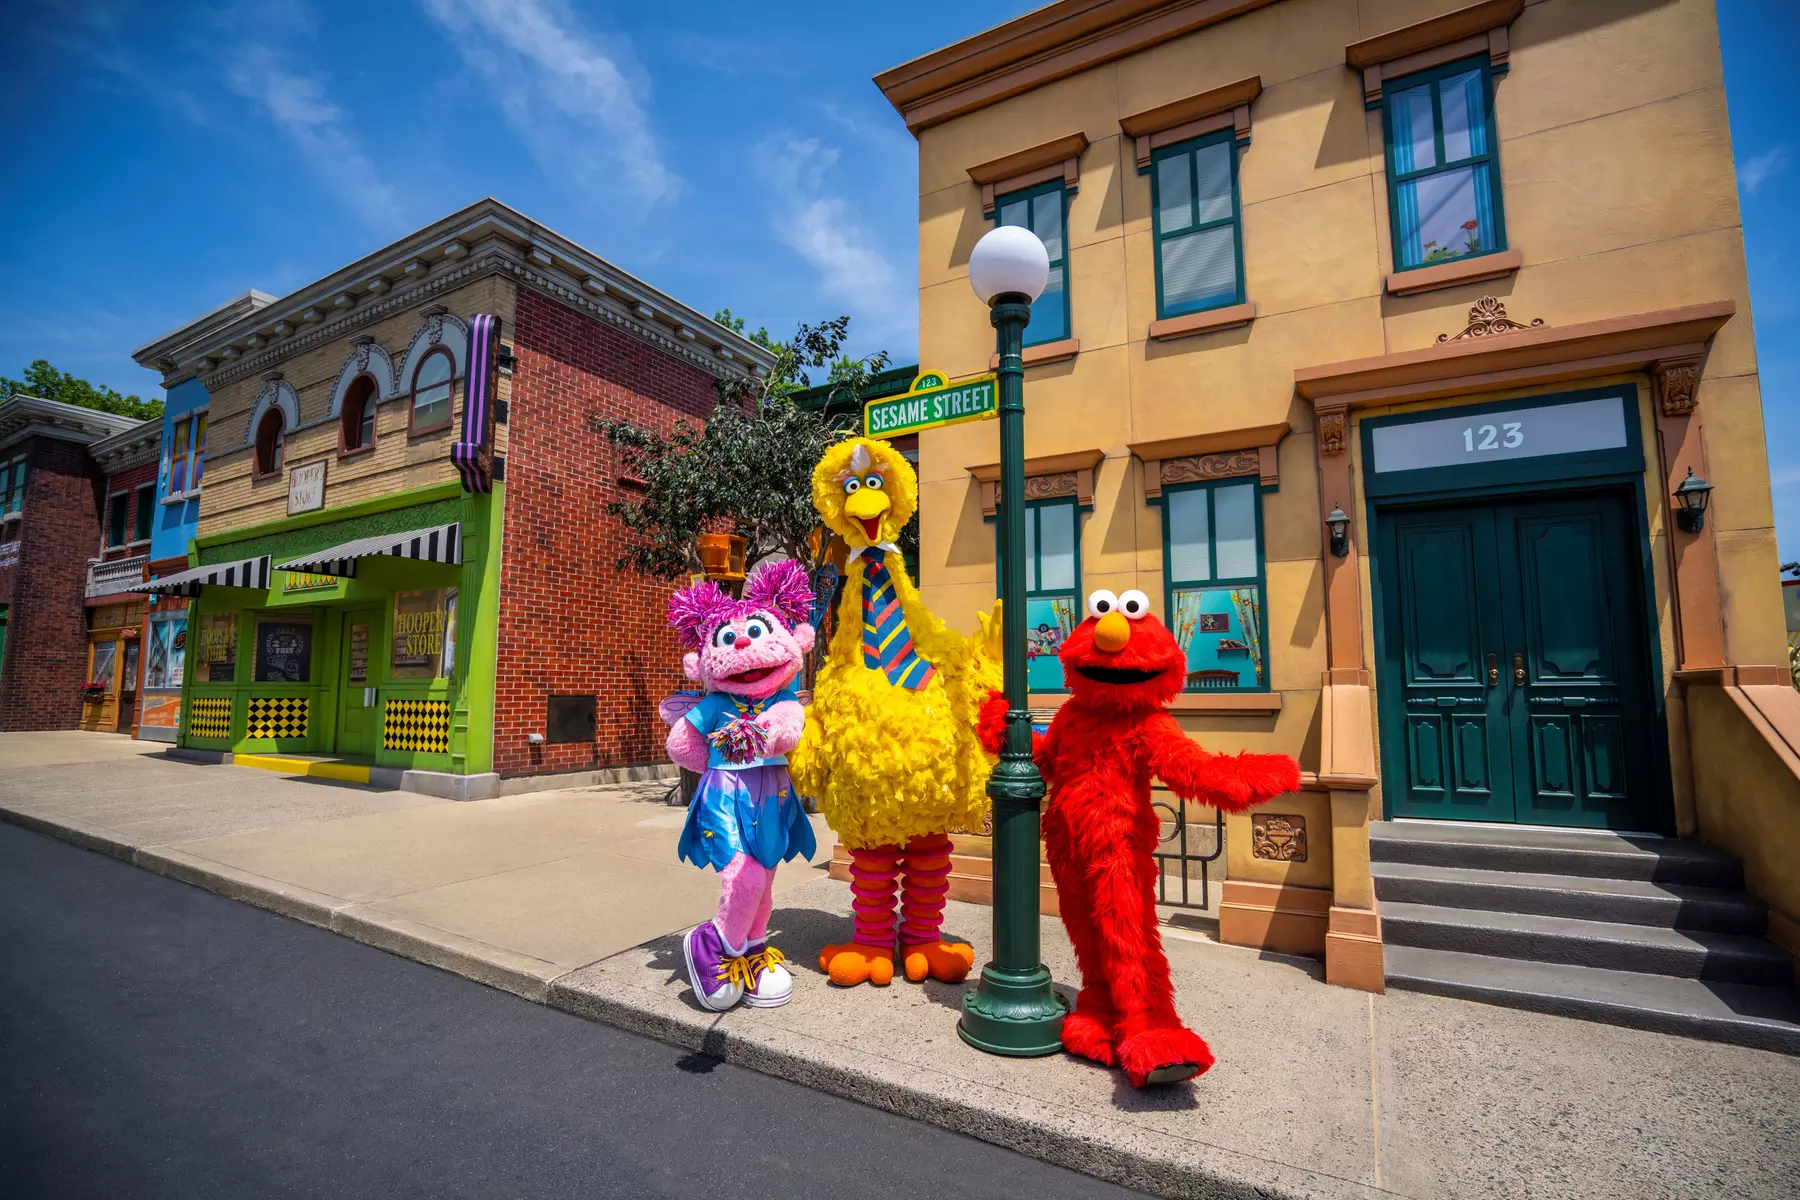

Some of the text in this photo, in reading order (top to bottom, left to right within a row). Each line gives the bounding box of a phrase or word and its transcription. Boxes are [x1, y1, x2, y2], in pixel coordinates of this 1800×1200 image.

[922, 378, 937, 388] 123
[872, 385, 991, 431] SESAME STREET
[1463, 421, 1524, 452] 123
[398, 609, 454, 634] HOOPER'S
[272, 640, 280, 648] 2
[290, 639, 297, 647] 1
[406, 633, 441, 656] STORE
